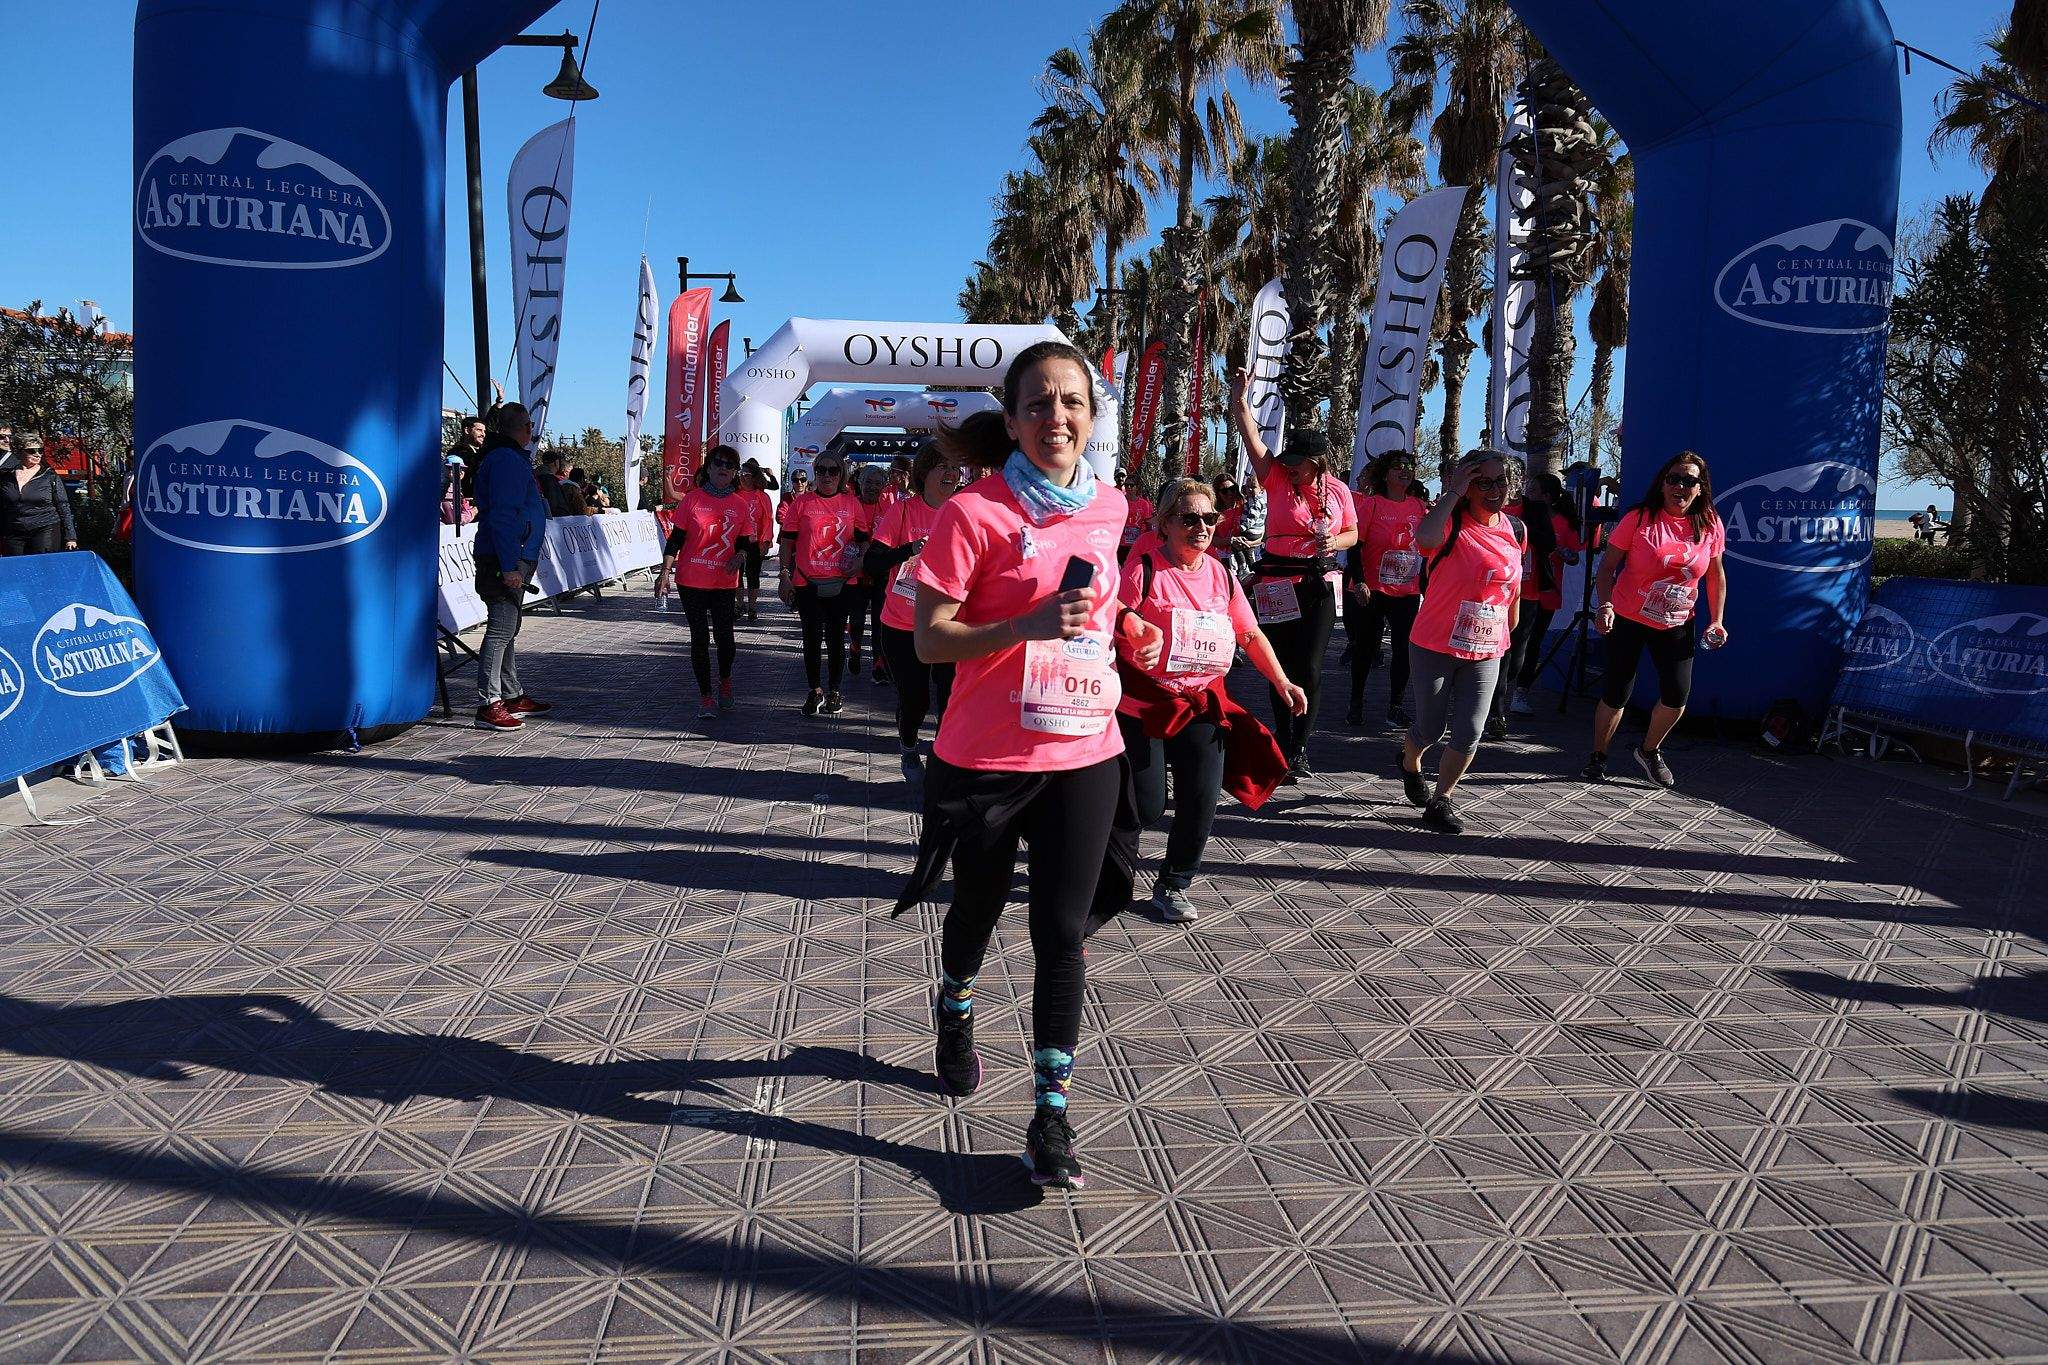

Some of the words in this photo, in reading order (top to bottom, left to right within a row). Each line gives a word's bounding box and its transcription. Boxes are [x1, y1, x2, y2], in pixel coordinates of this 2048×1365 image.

[169, 173, 255, 190] CENTRAL
[266, 179, 364, 208] LECHERA
[143, 177, 373, 249] ASTURIANA
[1777, 259, 1852, 271] CENTRAL
[1732, 262, 1892, 306] ASTURIAN
[680, 313, 699, 405] Santander
[844, 333, 1003, 369] OYSHO
[747, 367, 796, 380] OYSHO
[1136, 360, 1158, 431] Santander
[725, 432, 770, 444] OYSHO
[854, 439, 919, 448] VOLVO
[674, 433, 691, 488] Sports
[168, 462, 253, 479] CENTRAL
[263, 467, 360, 487] LECHERA
[144, 464, 369, 525] ASTURIANA
[1761, 499, 1835, 511] CENTRAL
[1725, 501, 1873, 544] ASTURIAN
[1474, 625, 1493, 636] 016
[1194, 639, 1217, 653] 016
[45, 637, 155, 681] ASTURIANA
[1065, 676, 1102, 696] 016
[1071, 698, 1089, 708] 4862
[1034, 716, 1070, 729] OYSHO
